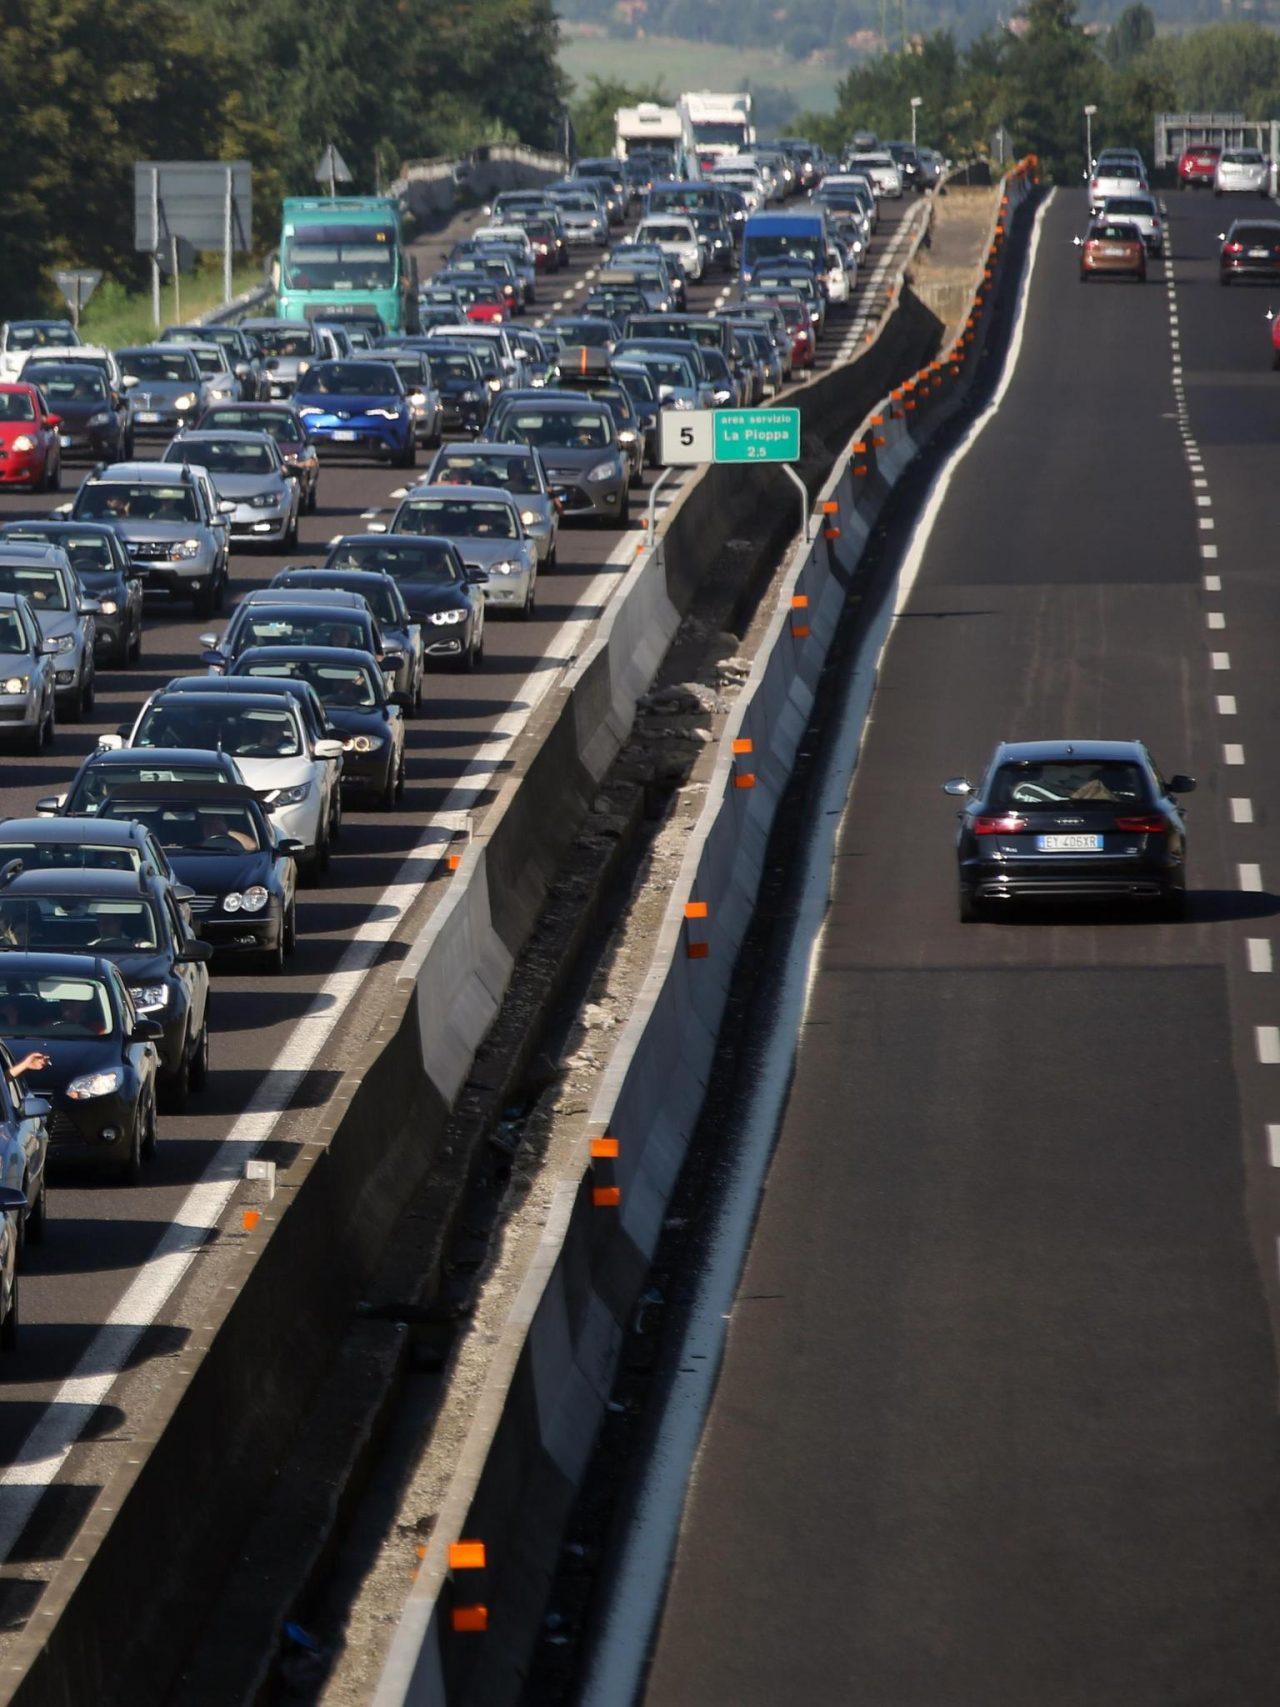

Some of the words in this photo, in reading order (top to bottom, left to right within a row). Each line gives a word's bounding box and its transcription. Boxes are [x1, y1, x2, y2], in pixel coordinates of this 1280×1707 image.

[721, 416, 744, 424] area
[750, 414, 791, 424] servizio
[680, 427, 694, 446] 5
[723, 430, 739, 441] La
[745, 429, 789, 442] Pioppa
